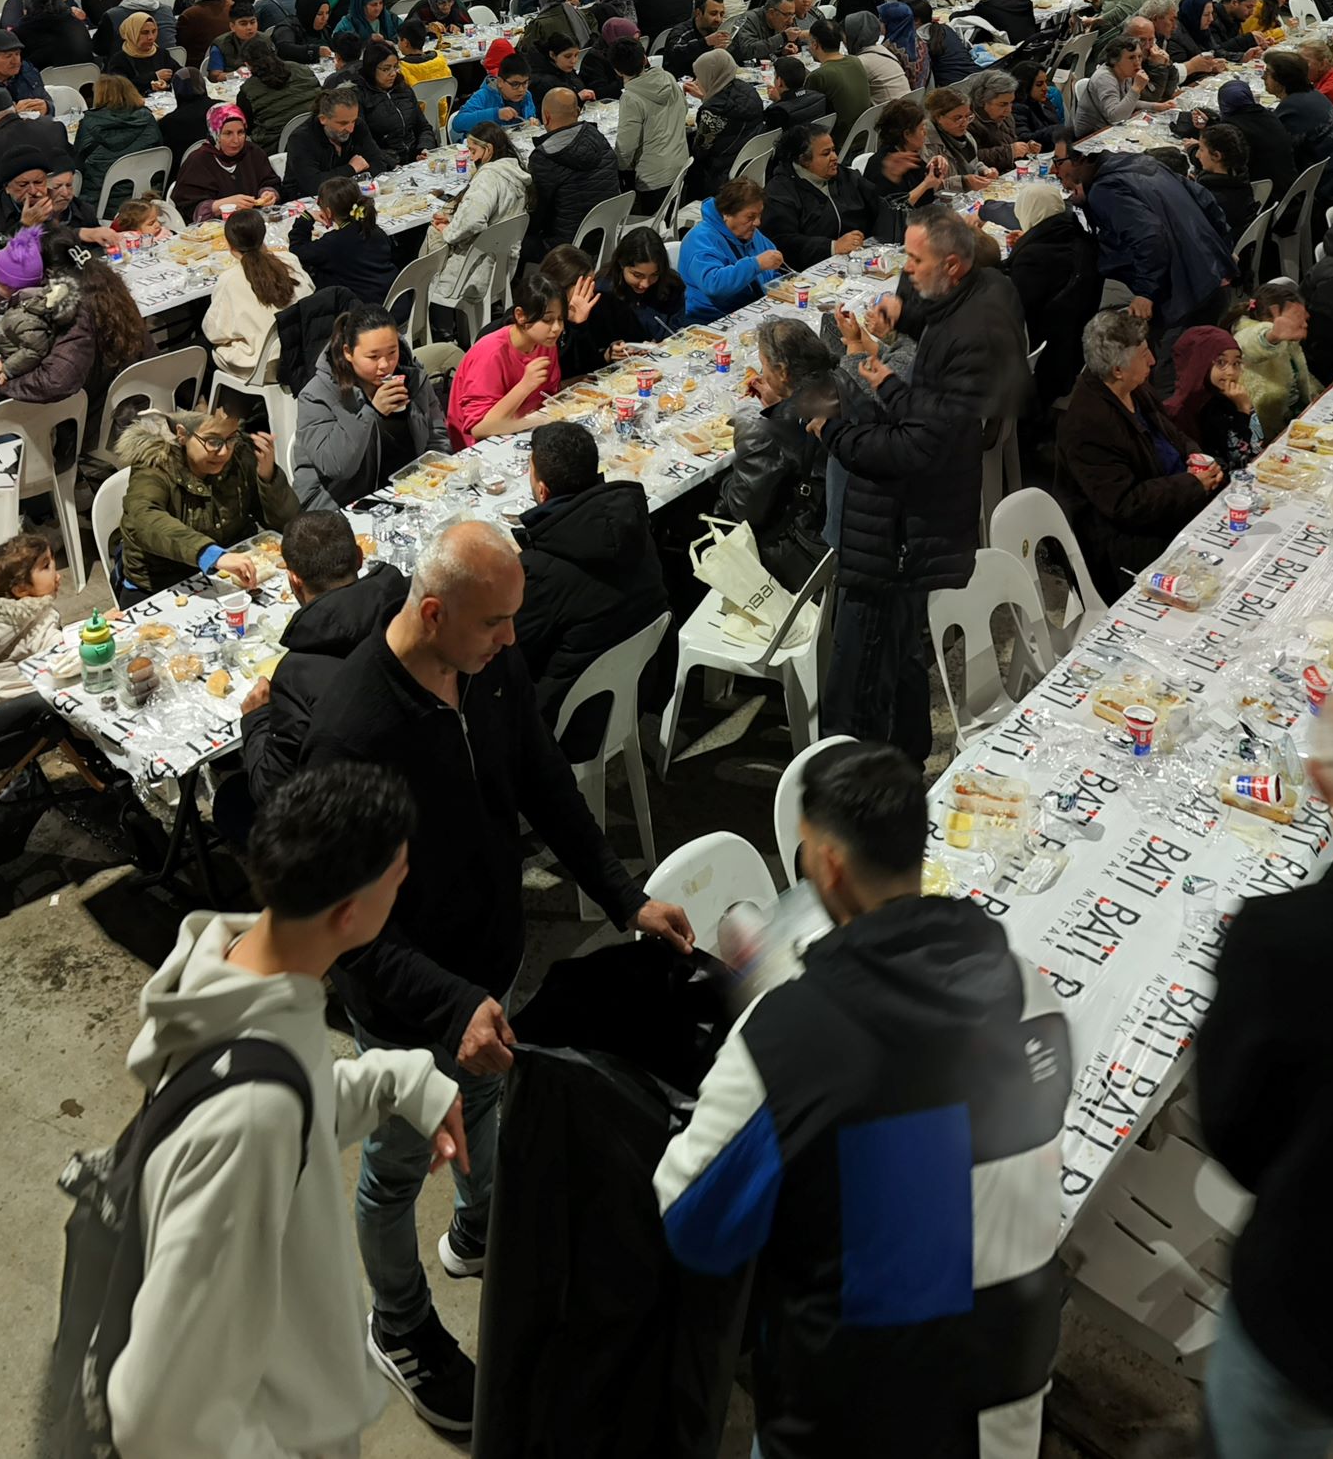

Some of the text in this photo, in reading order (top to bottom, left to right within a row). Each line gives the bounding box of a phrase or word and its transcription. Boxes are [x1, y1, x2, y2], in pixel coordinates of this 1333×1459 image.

[1256, 557, 1308, 594] BATI
[1101, 827, 1148, 878] MUTFAK
[1116, 835, 1192, 897] BATI
[1039, 888, 1097, 946] MUTFAK
[1056, 896, 1142, 966] BATI
[1113, 974, 1169, 1037] MUTFAK
[1131, 982, 1215, 1063] BATI
[1071, 1050, 1109, 1101] MUTF
[1063, 1061, 1161, 1153] BATI
